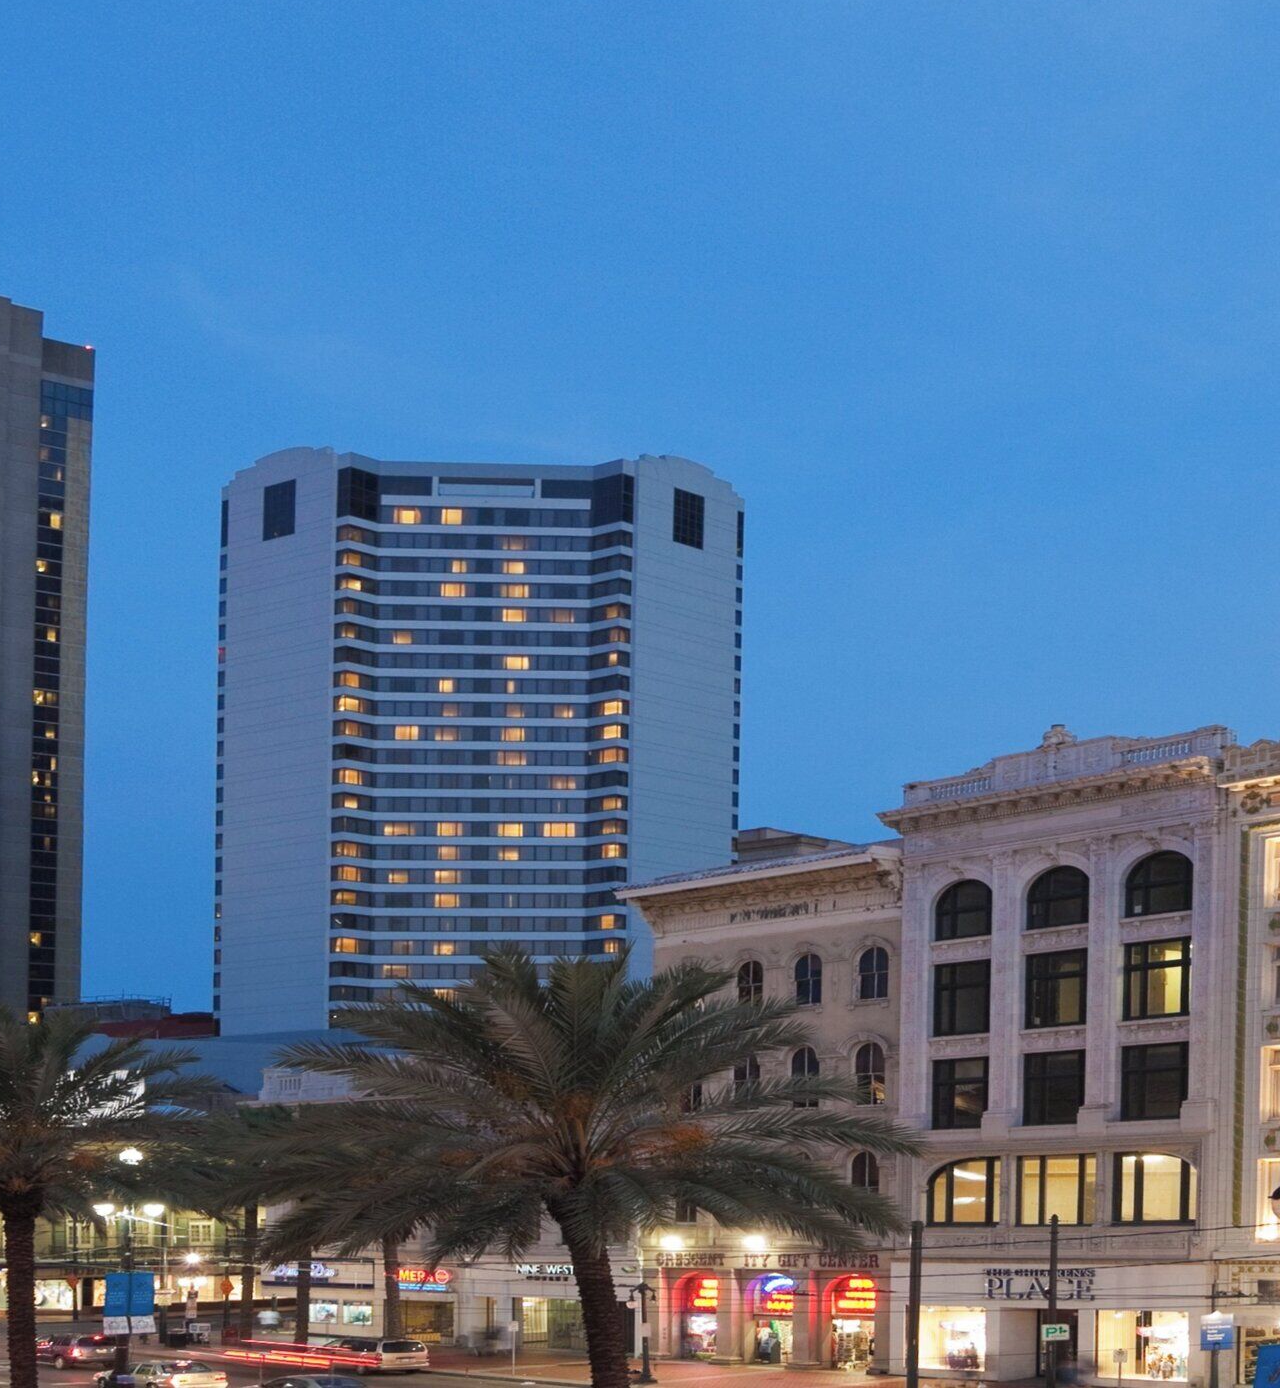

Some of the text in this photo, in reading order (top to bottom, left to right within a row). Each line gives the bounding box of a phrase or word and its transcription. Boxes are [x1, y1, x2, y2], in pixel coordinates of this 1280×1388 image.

[655, 1252, 726, 1267] CRESCENT
[778, 1253, 810, 1268] GIFT
[819, 1253, 881, 1269] CENTER
[516, 1264, 576, 1275] NINE WEST
[983, 1268, 1096, 1277] THE CHILREN'S
[984, 1276, 1095, 1301] PLACE
